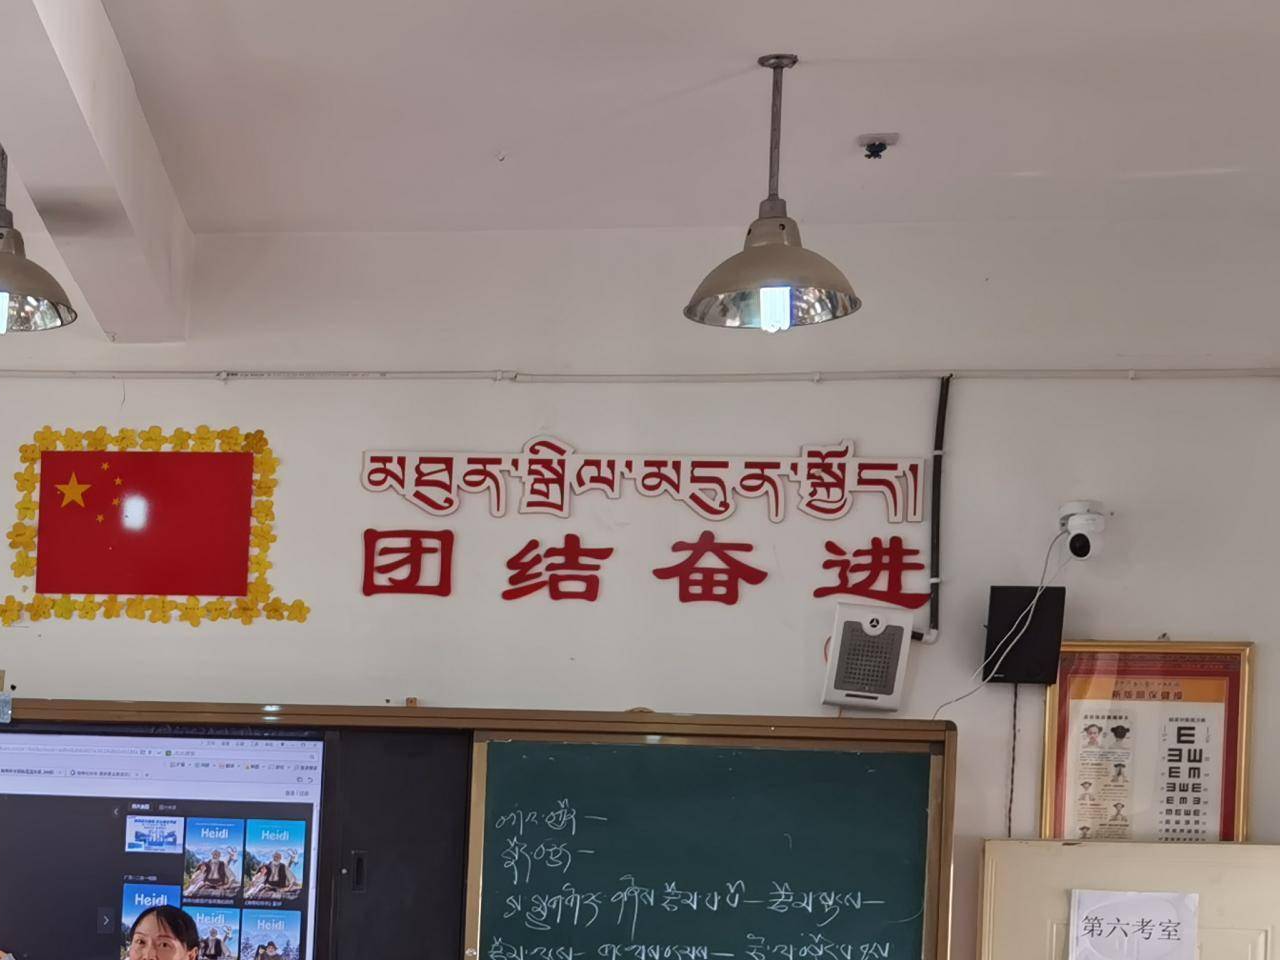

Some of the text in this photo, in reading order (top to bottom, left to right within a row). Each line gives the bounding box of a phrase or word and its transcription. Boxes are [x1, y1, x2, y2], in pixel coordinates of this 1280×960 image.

[363, 529, 932, 609] 团结奋进
[200, 827, 229, 840] Heidi
[261, 829, 289, 842] Heidi
[134, 893, 168, 907] Heidi
[196, 912, 225, 925] Heidi
[257, 919, 285, 931] Heidi
[1079, 915, 1183, 942] 第六考室
